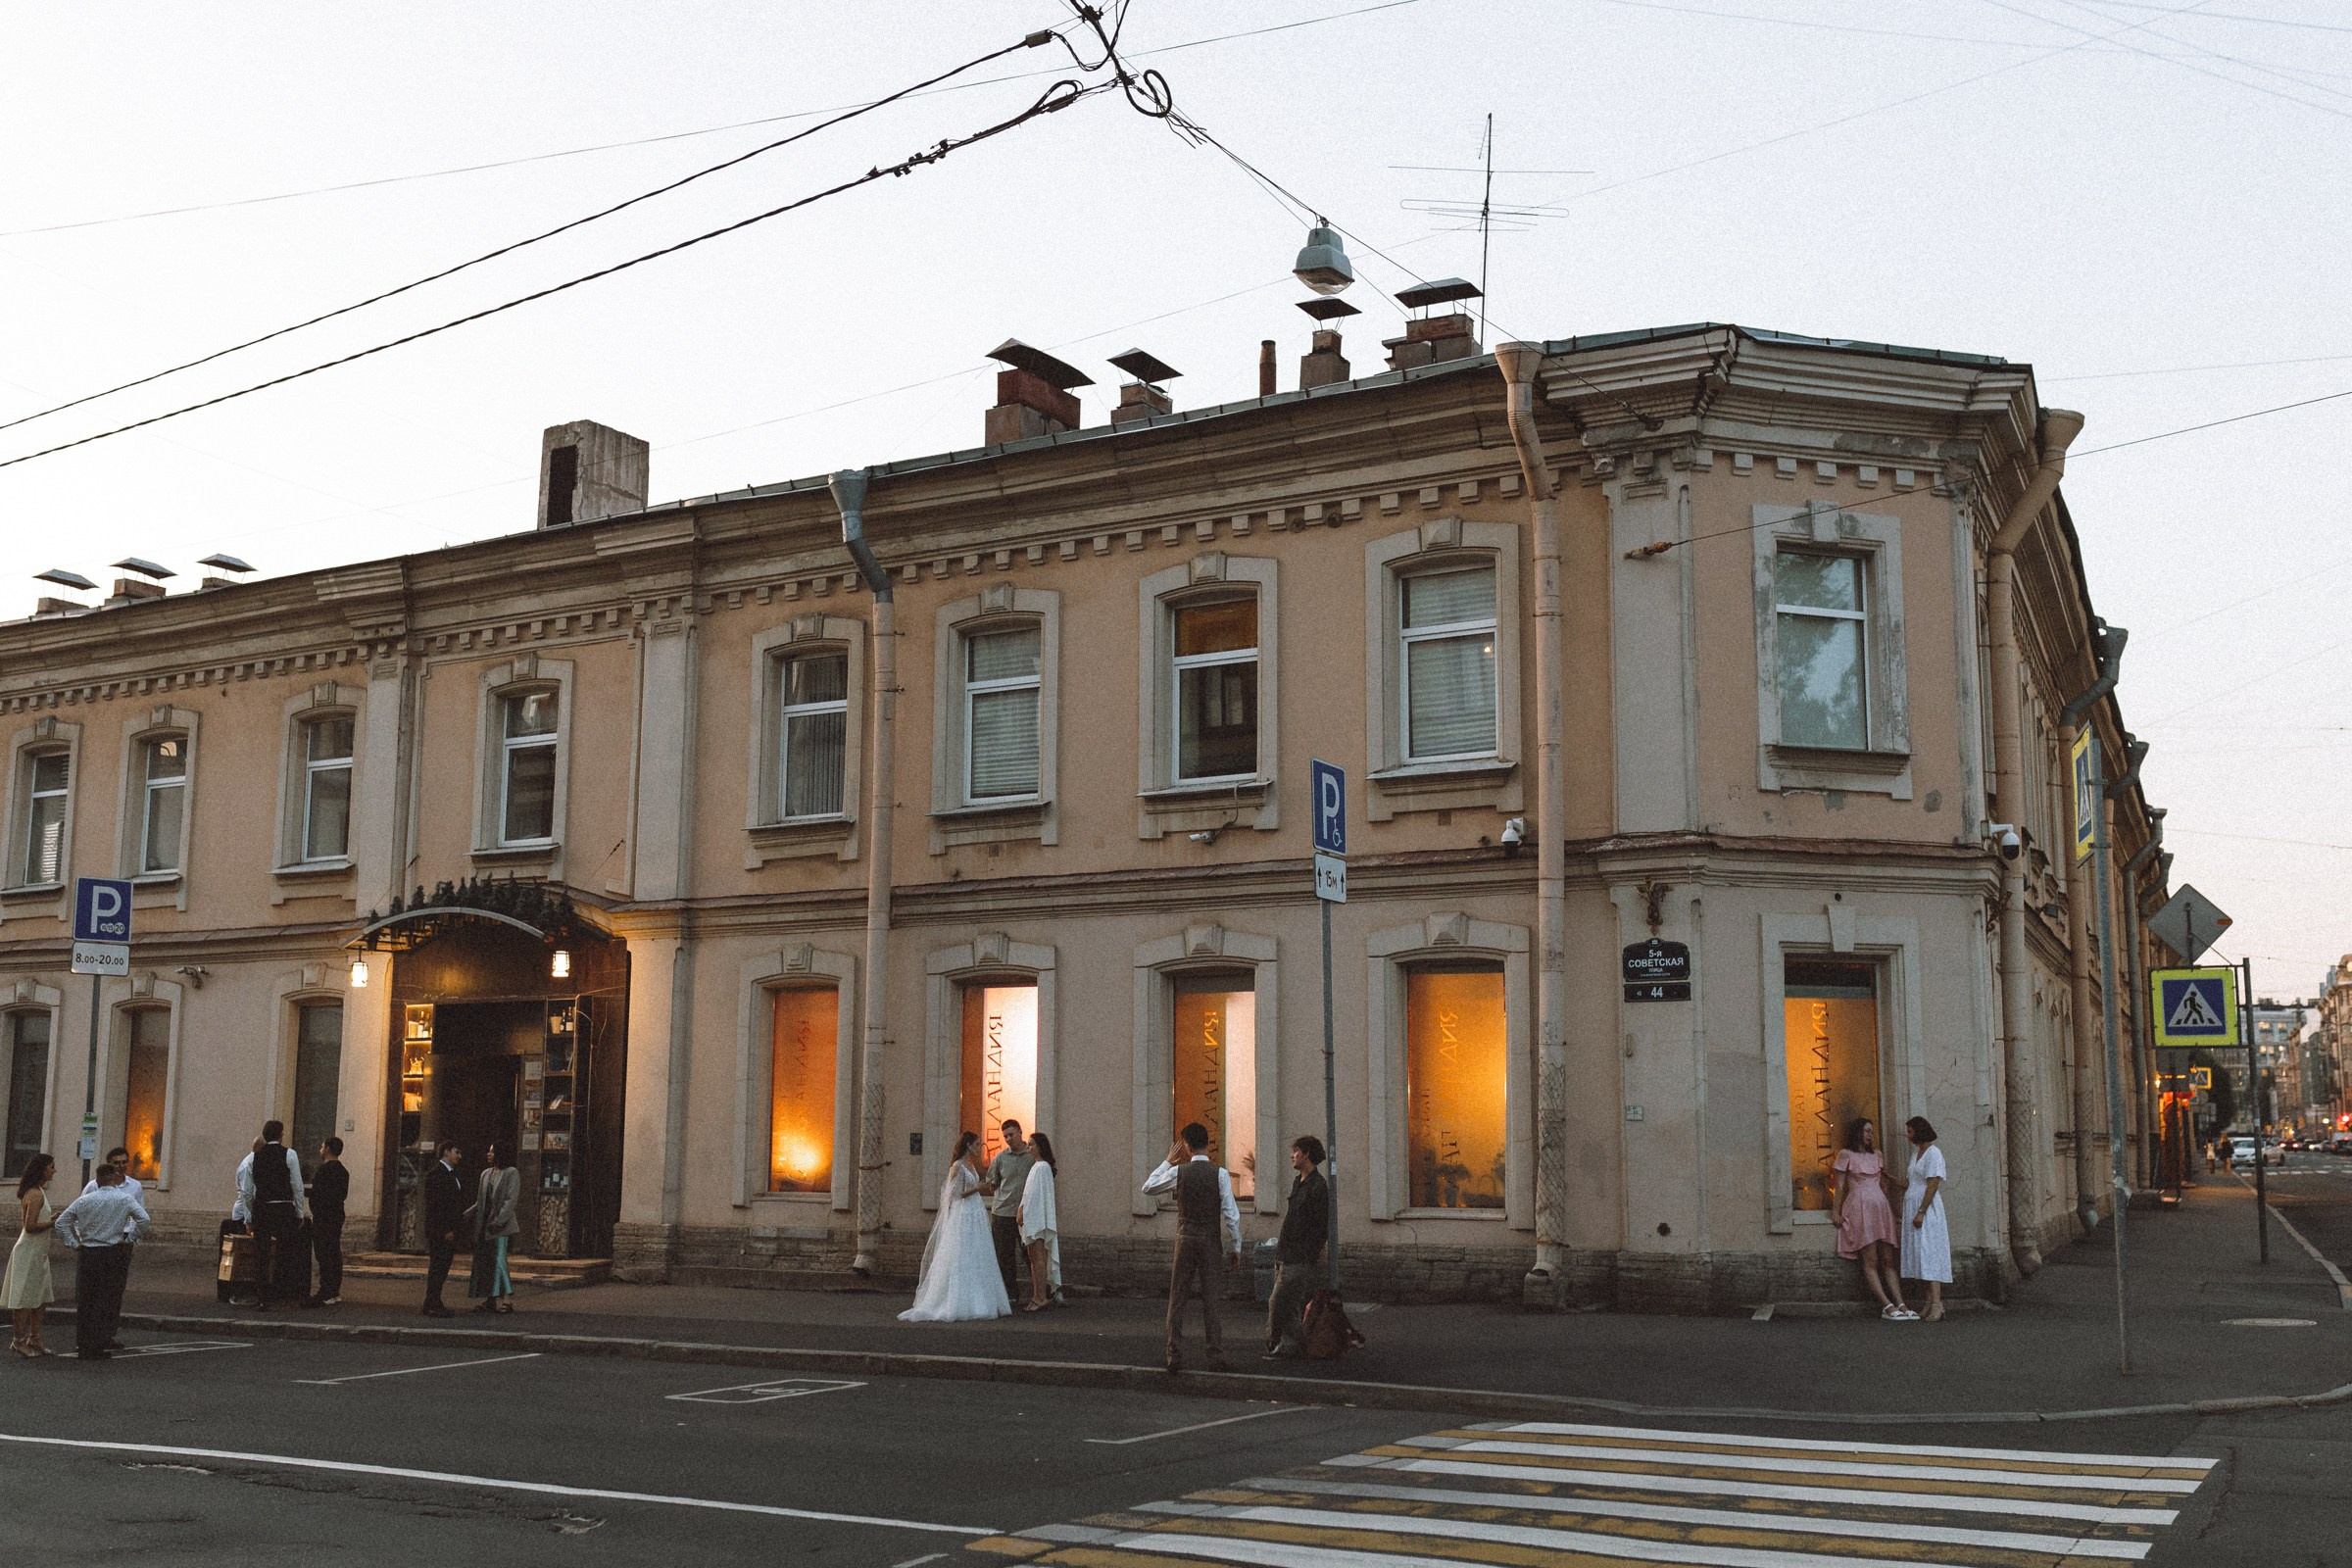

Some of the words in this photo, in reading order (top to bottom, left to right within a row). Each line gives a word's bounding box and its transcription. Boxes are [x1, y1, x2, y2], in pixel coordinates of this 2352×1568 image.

[1321, 772, 1340, 840] P
[90, 885, 122, 933] P
[75, 953, 123, 965] 8.00-20.00
[1628, 957, 1684, 968] СОВЕТСКАЯ
[1648, 949, 1662, 957] 5-я
[1650, 987, 1663, 998] 44
[986, 1013, 1004, 1163] АПЛАНДИЯ
[1201, 1011, 1220, 1163] АЛАНДИЯ
[1439, 1010, 1460, 1190] АПДИЯ
[1810, 1003, 1836, 1194] АПЛАНДИЯ
